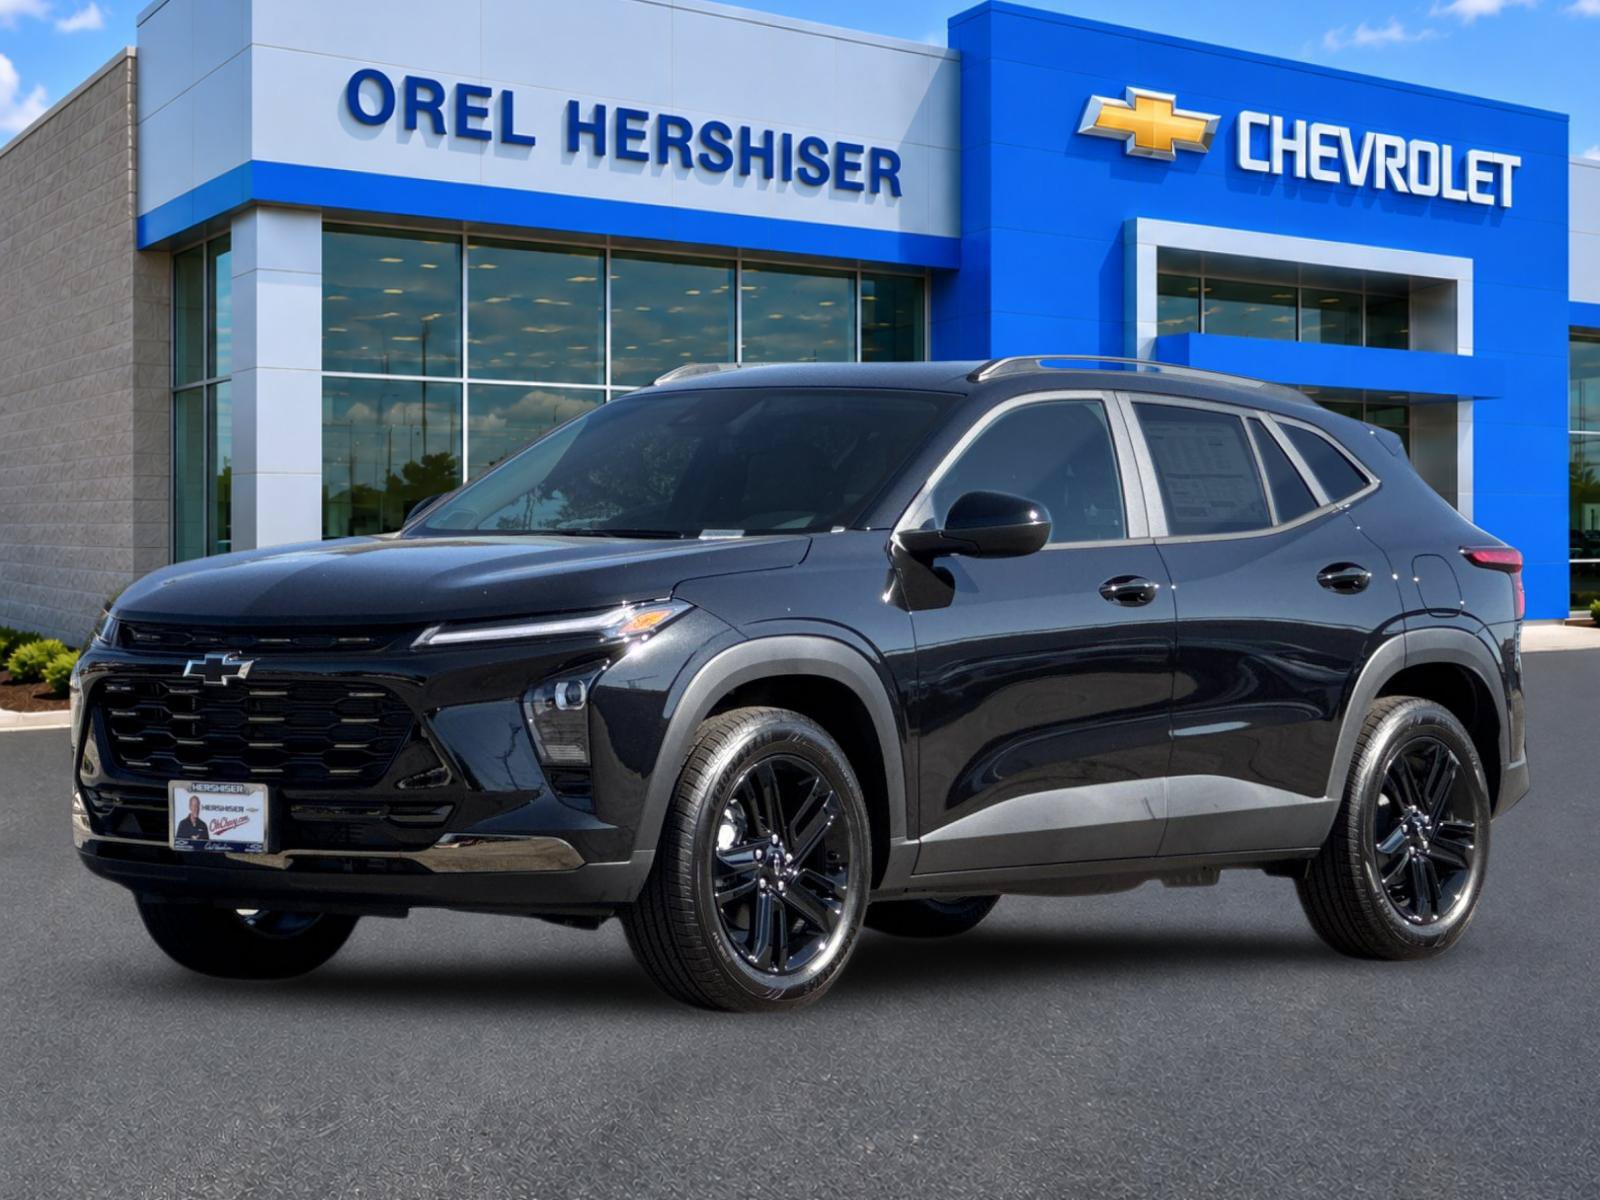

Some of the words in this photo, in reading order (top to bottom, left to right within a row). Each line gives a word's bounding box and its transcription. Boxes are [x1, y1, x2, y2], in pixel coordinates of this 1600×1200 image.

[346, 68, 535, 147] OREL
[567, 99, 902, 197] HERSHISER
[1237, 109, 1521, 208] CHEVROLET
[191, 783, 244, 793] HERSHISER
[201, 804, 244, 812] HERSHISER
